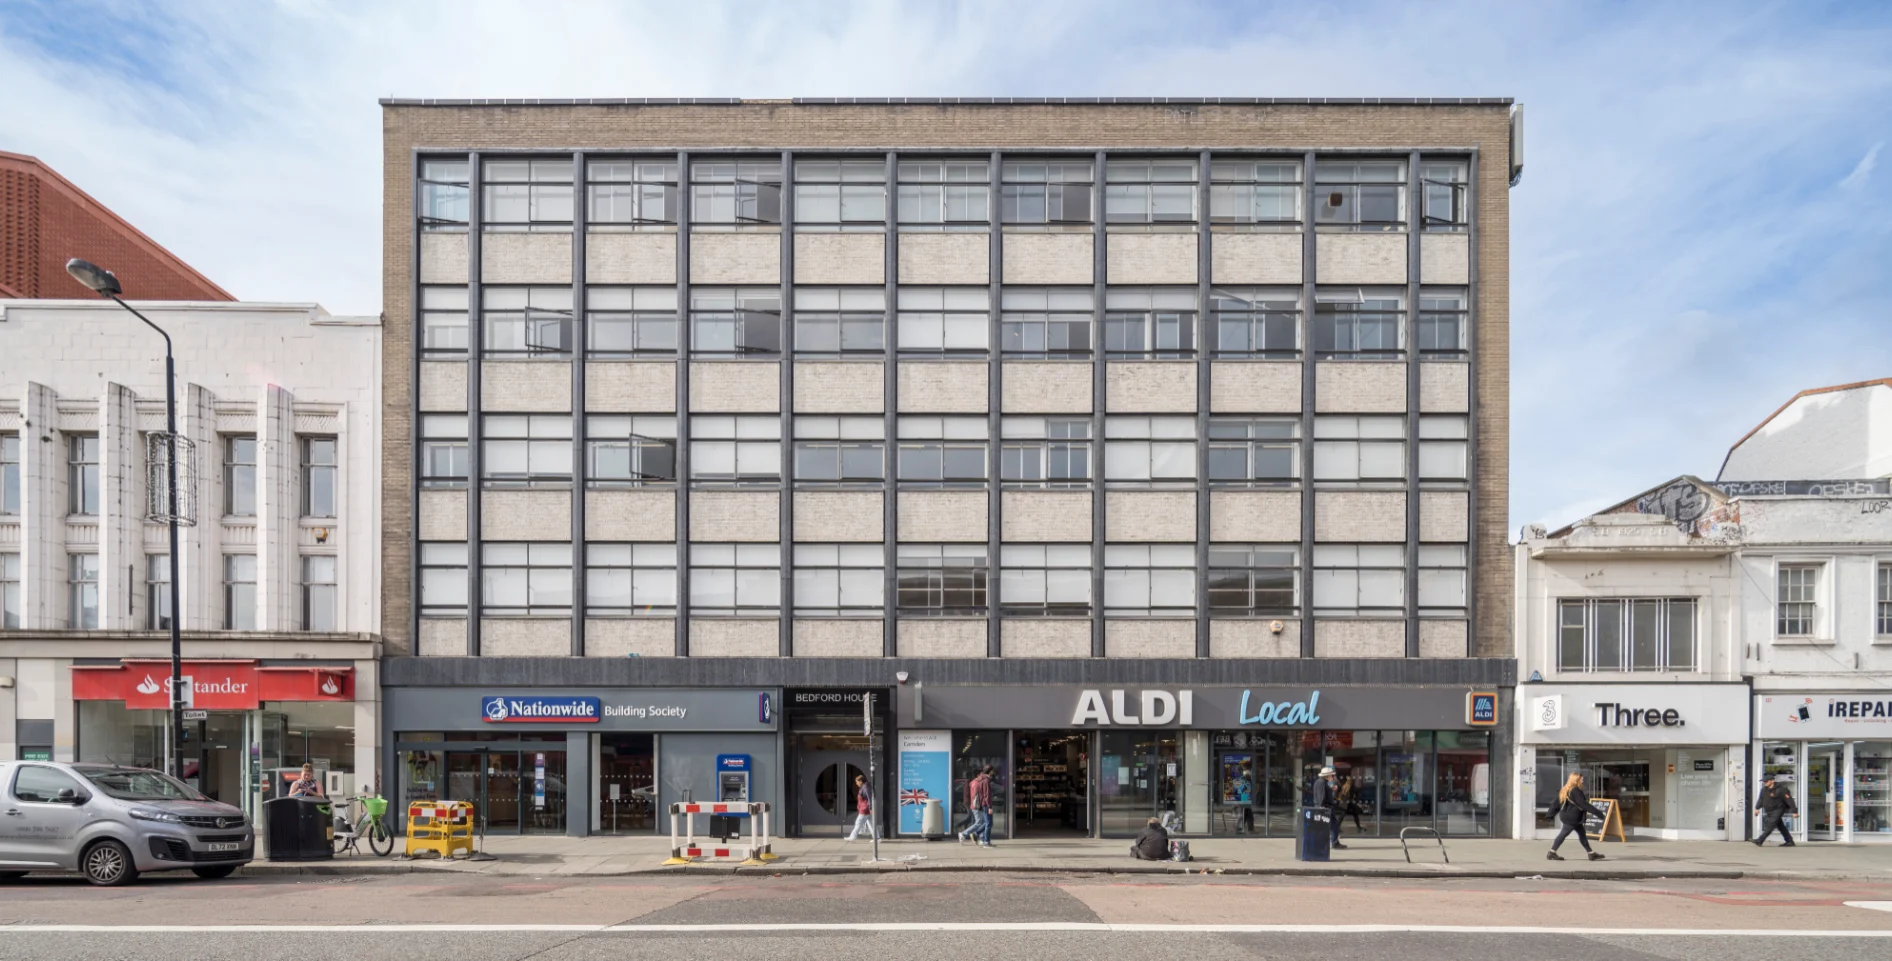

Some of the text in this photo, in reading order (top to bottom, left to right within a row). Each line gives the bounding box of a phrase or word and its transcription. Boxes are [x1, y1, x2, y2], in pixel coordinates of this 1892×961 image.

[163, 677, 249, 693] Stander
[795, 693, 877, 702] BEDFORD HOUE
[1071, 689, 1320, 725] ALDI Local
[511, 700, 687, 719] Nationwide Building Society
[1594, 702, 1685, 727] Three.
